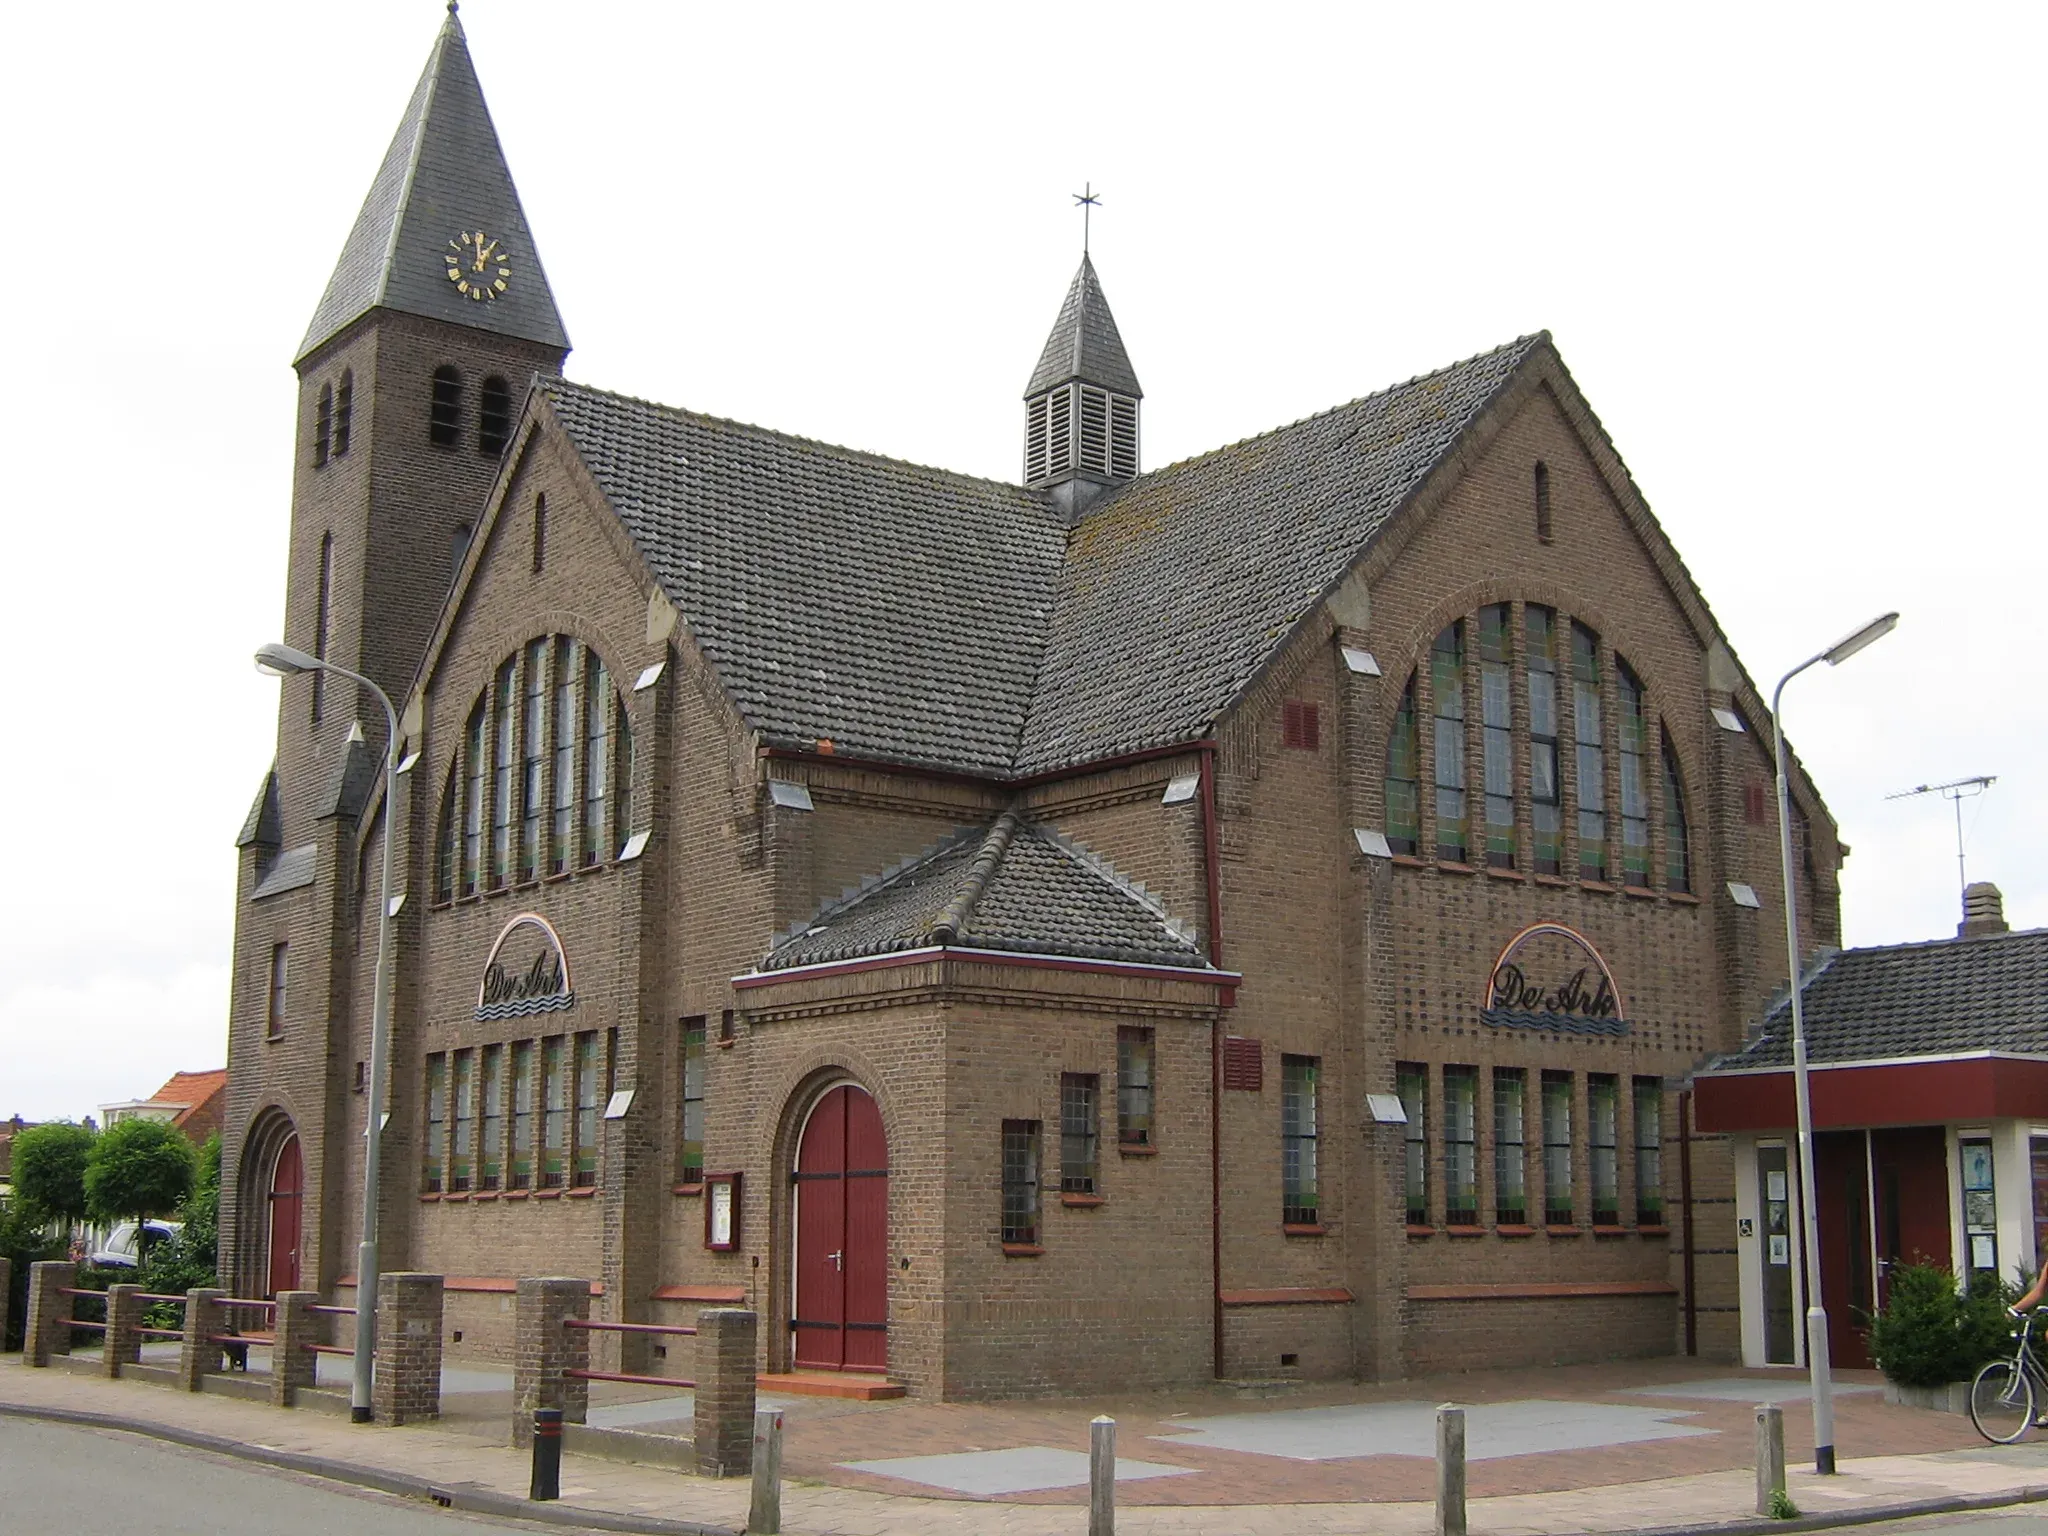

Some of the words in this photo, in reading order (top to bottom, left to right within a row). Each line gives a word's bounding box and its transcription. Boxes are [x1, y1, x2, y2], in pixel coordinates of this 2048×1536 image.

[484, 963, 517, 1000] De
[519, 949, 563, 997] Ark
[1494, 964, 1544, 1009] De
[1545, 967, 1614, 1016] Ark
